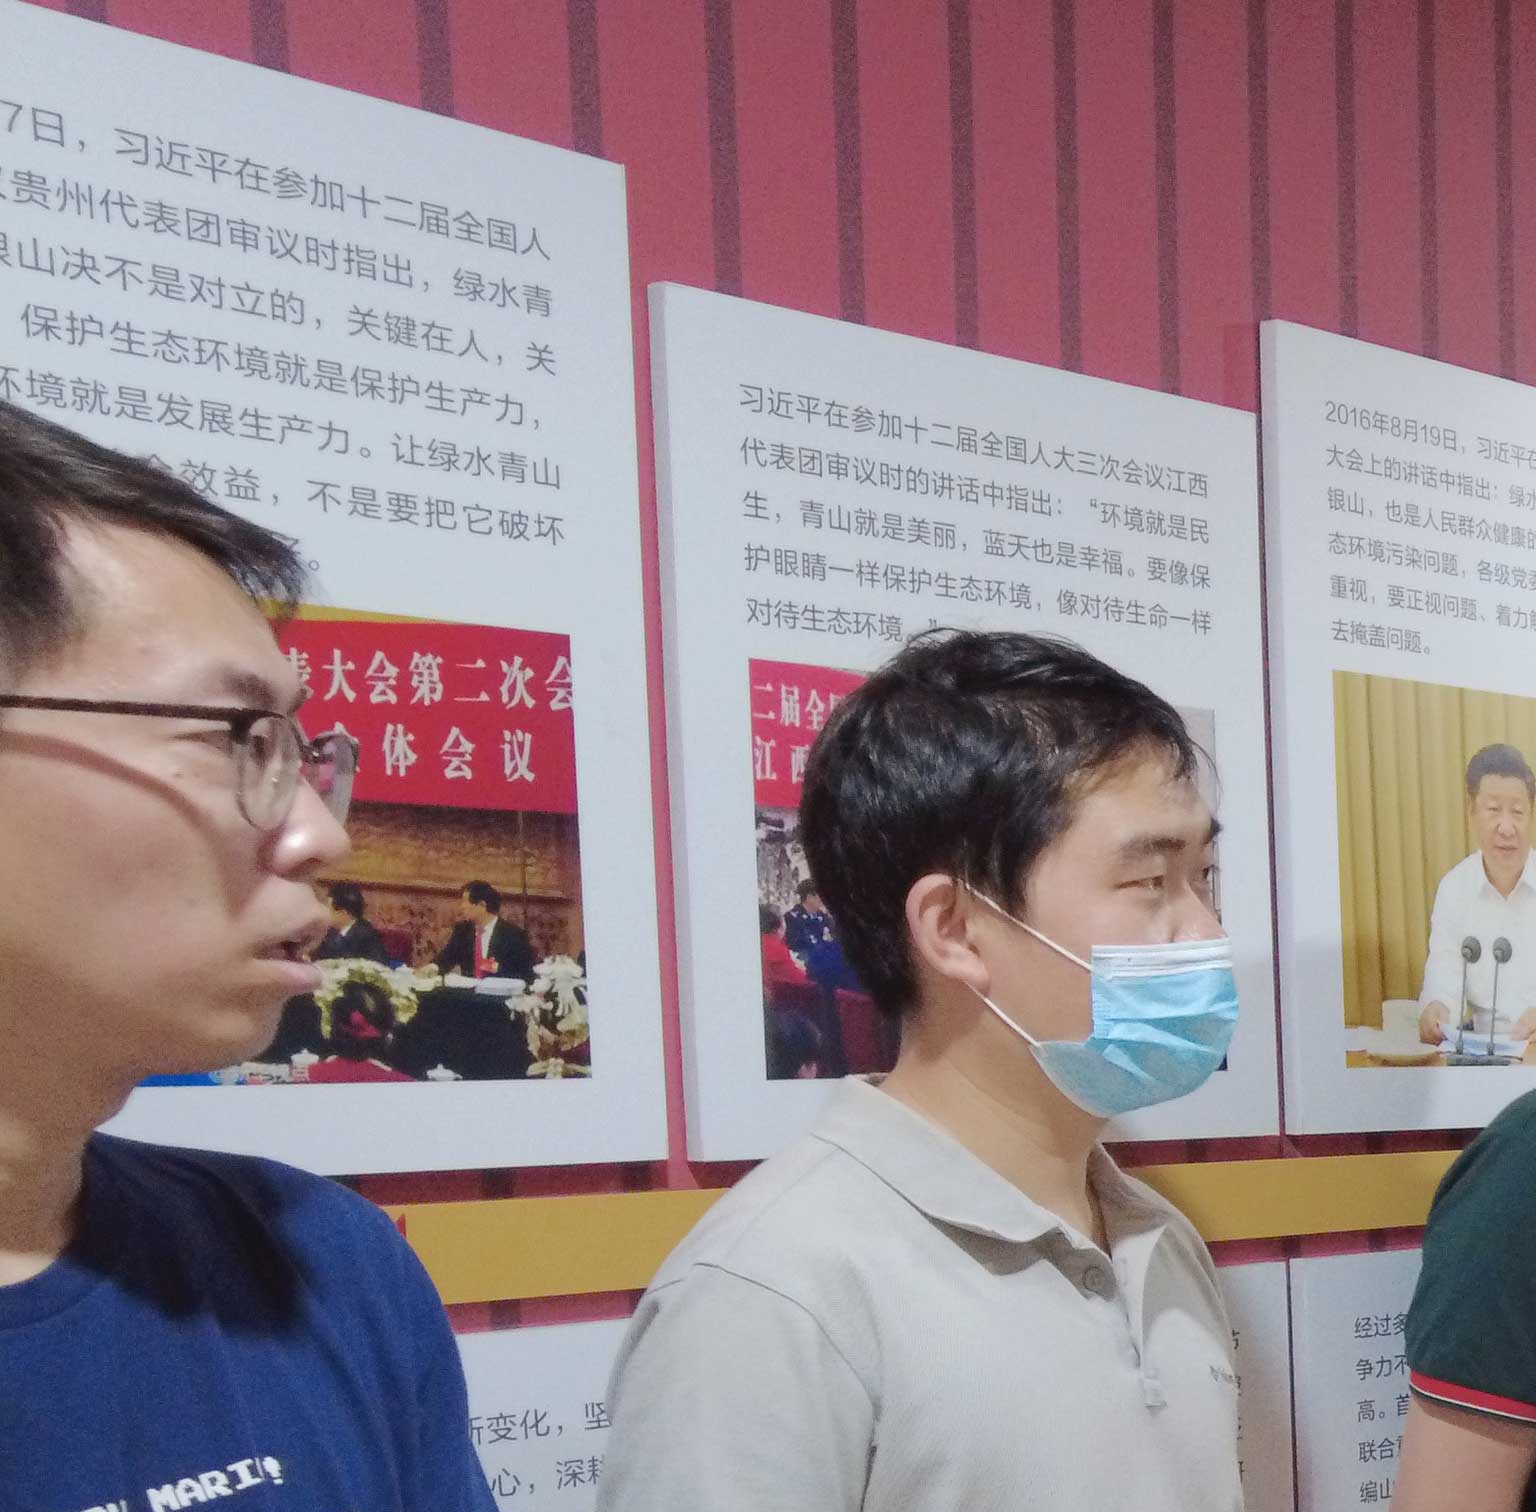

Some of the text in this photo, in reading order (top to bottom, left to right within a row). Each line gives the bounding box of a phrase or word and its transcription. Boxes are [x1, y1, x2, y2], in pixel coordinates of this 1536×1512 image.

[0, 167, 553, 318] 贵州代表团审议时指出，绿水青
[21, 303, 541, 430] 保护生态环境就是保护生产力，
[738, 384, 1208, 498] 习近平在参加十二届全国人大三次会议江西
[743, 490, 1211, 589] 生，青山就是美丽，蓝天也是幸福。要像保
[744, 543, 1213, 636] 护眼睛一样保护生态环境，像对待生命一样
[1331, 619, 1431, 656] 去掩盖问题。
[752, 682, 842, 732] 二届全
[1359, 1435, 1403, 1462] 联合
